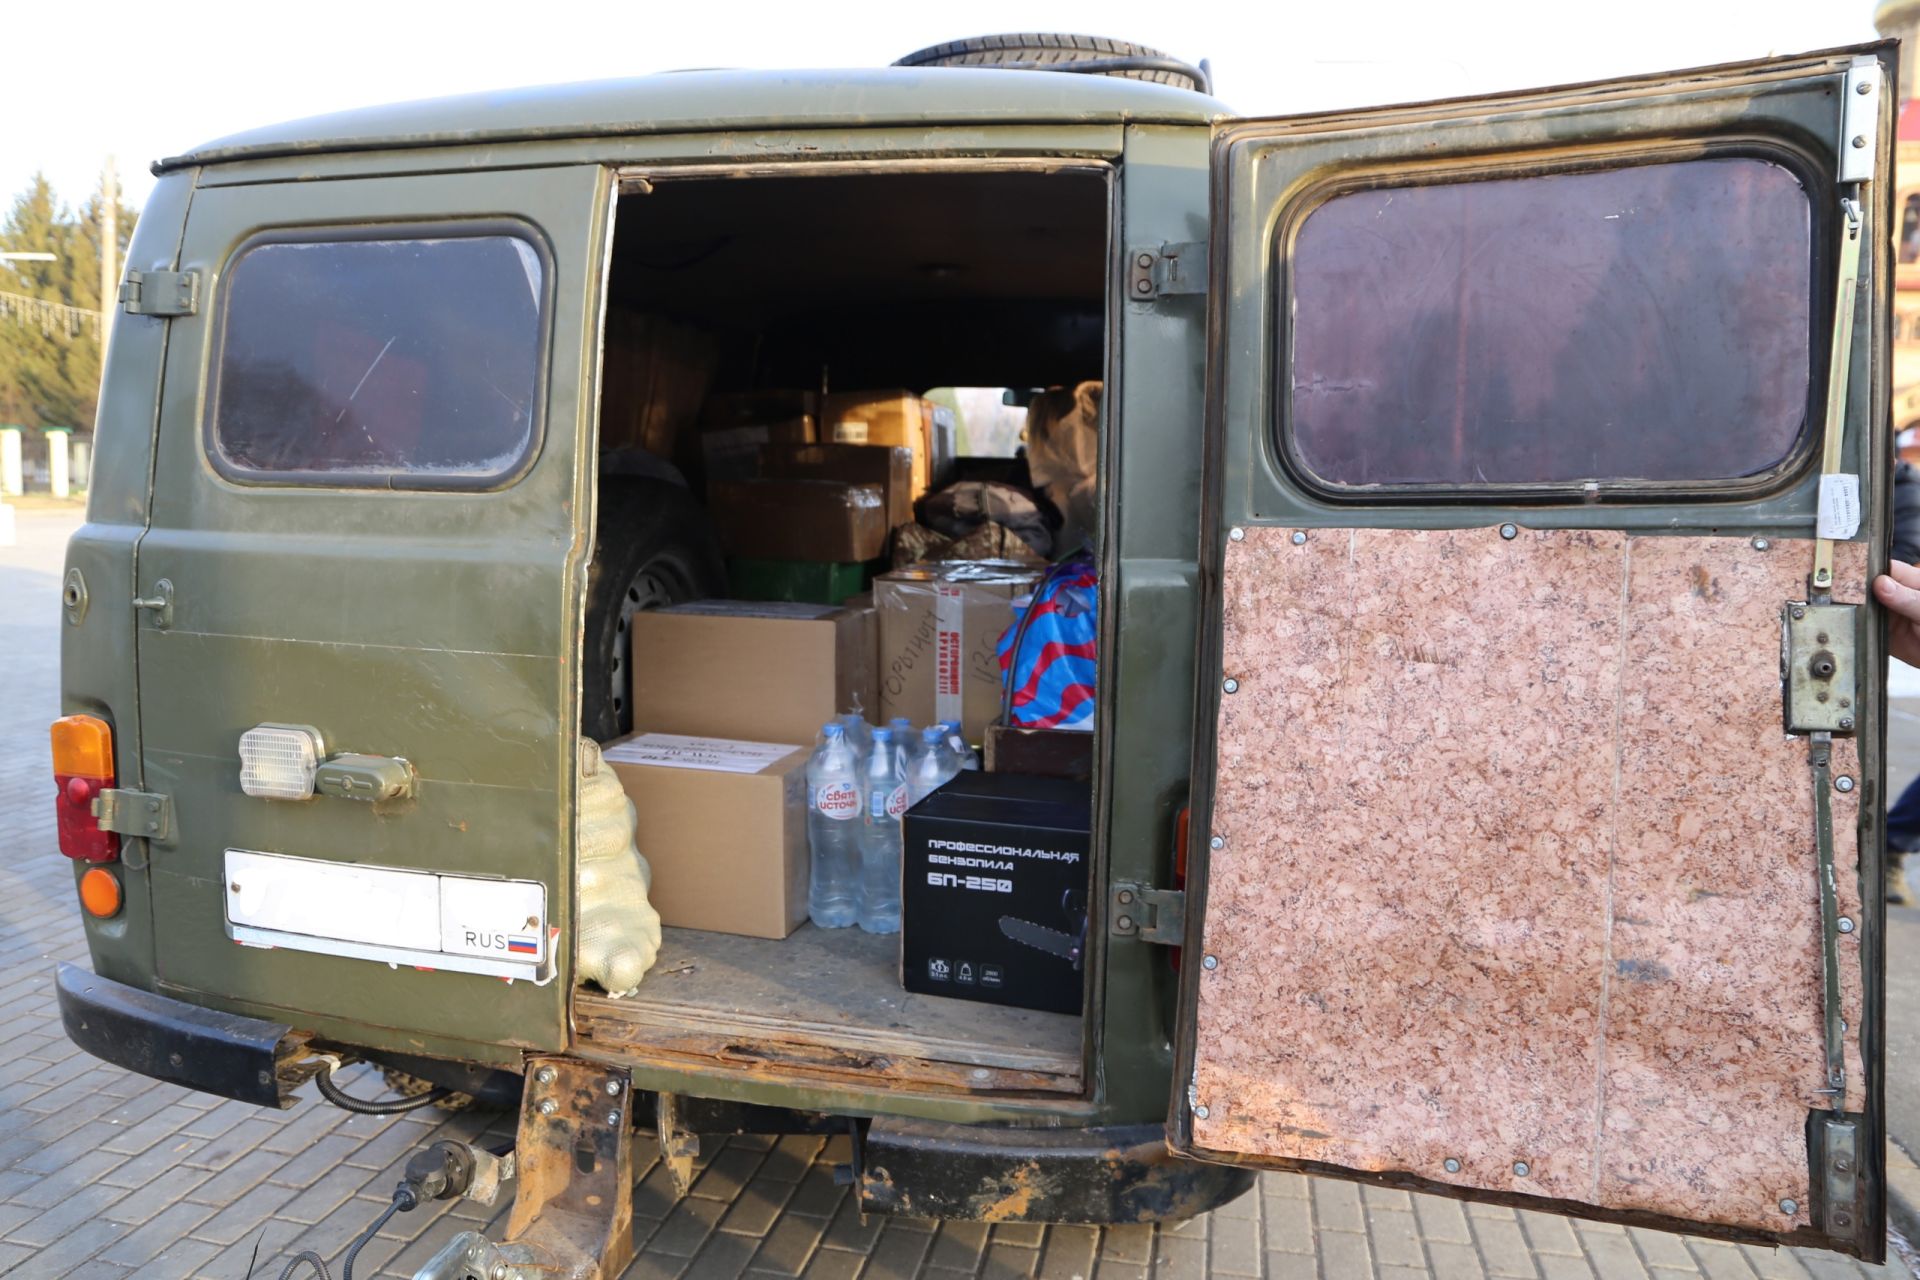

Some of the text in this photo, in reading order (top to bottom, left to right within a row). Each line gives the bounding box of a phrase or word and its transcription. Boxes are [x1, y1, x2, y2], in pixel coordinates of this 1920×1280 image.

[928, 854, 1014, 871] БЕНЗОПИЛА
[927, 872, 1013, 893] БП-250
[465, 931, 506, 950] RUS
